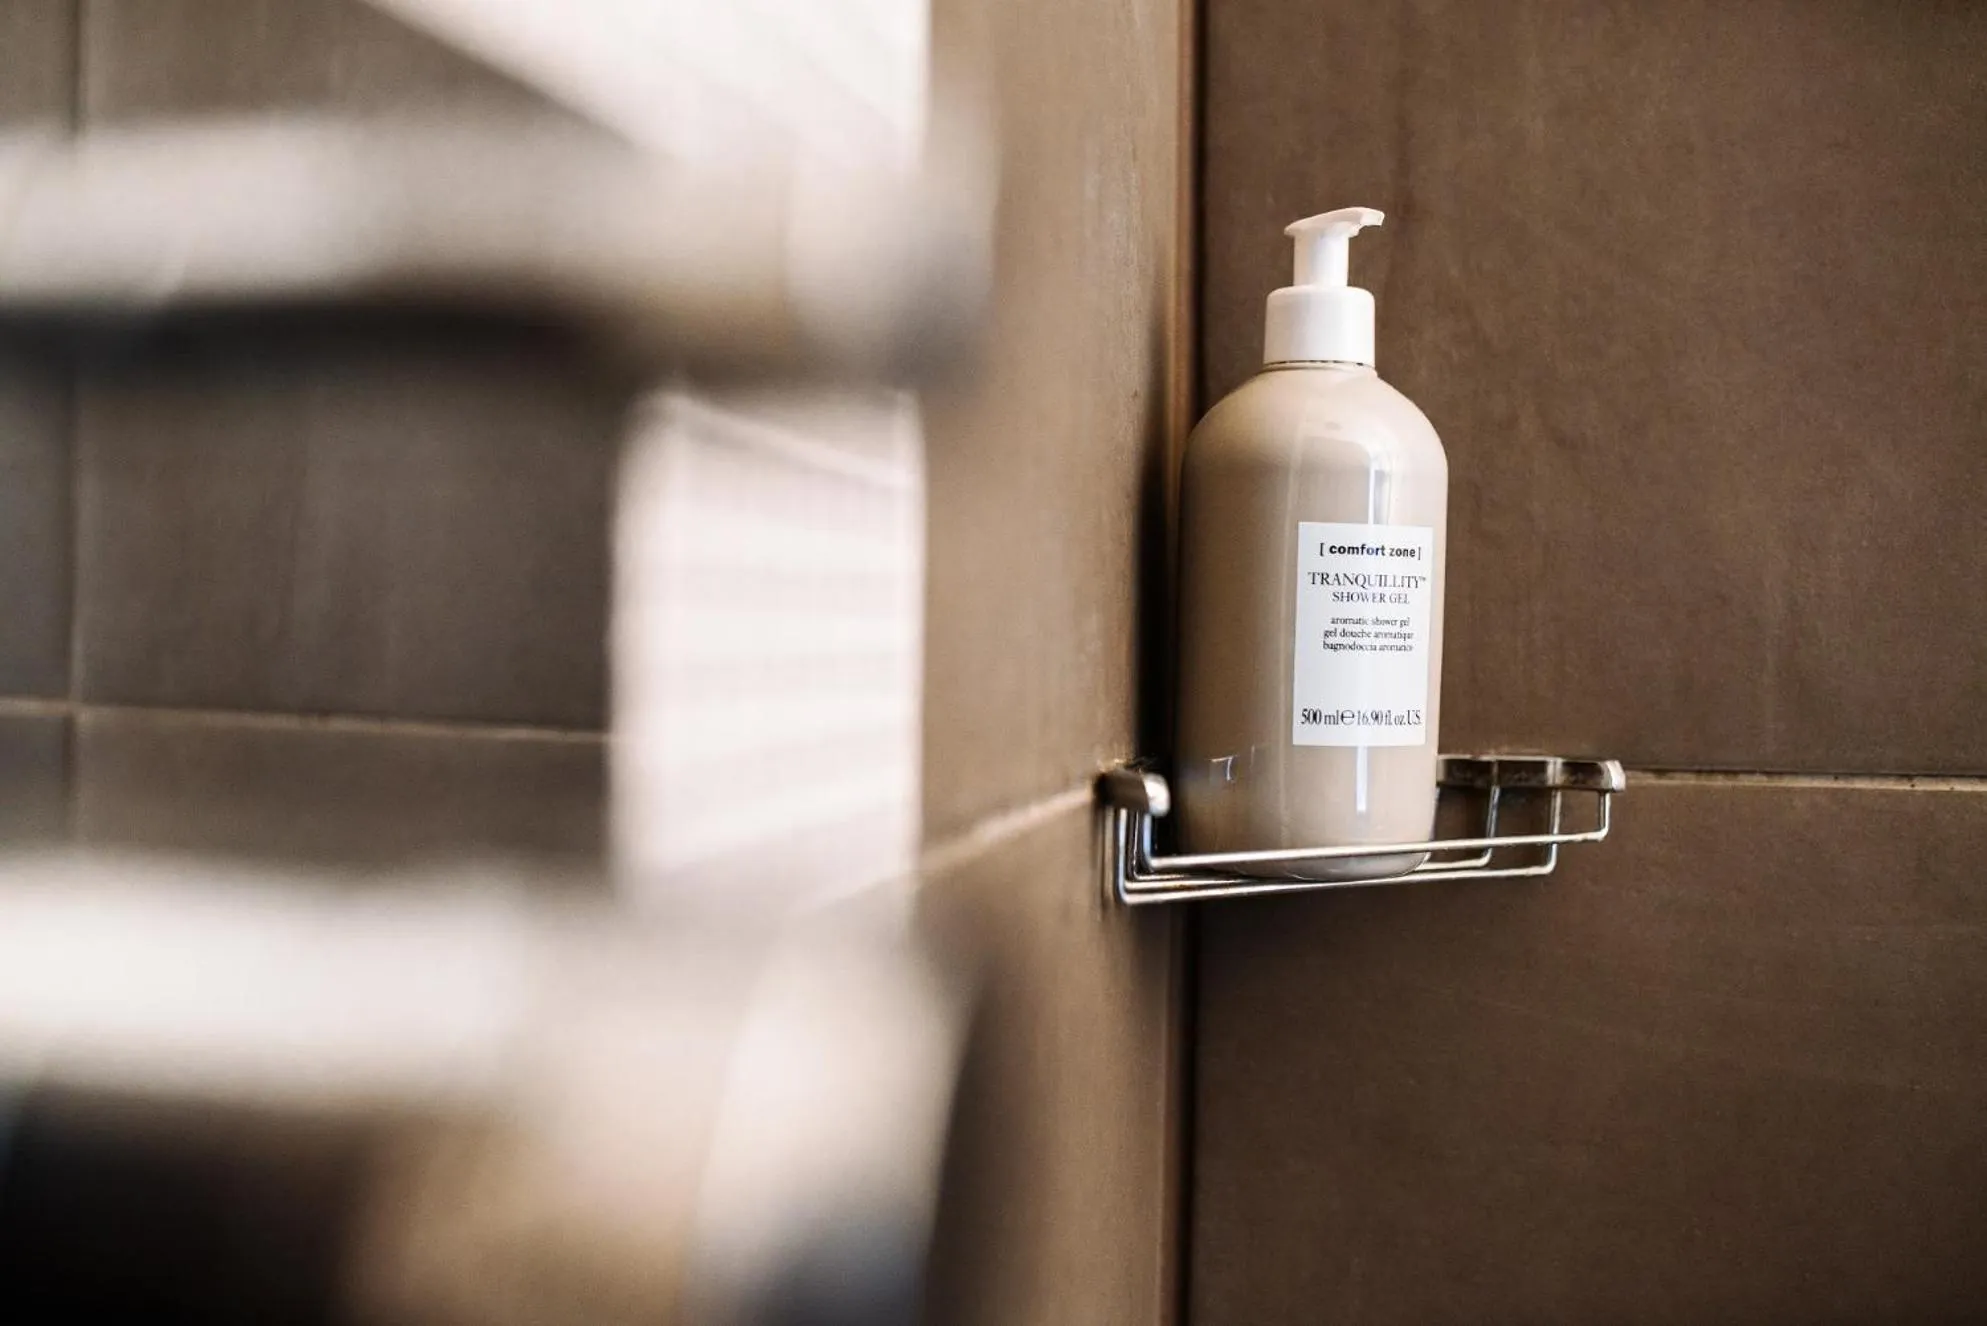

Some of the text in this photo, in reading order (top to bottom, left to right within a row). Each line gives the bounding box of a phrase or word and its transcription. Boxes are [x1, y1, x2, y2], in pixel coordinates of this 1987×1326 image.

[1329, 543, 1386, 557] comfort
[1332, 591, 1410, 604] SHOWER GEL
[1331, 616, 1410, 628] aromatic shower gel
[1323, 627, 1337, 639] gel
[1339, 627, 1372, 638] douche
[1301, 708, 1322, 725] 500
